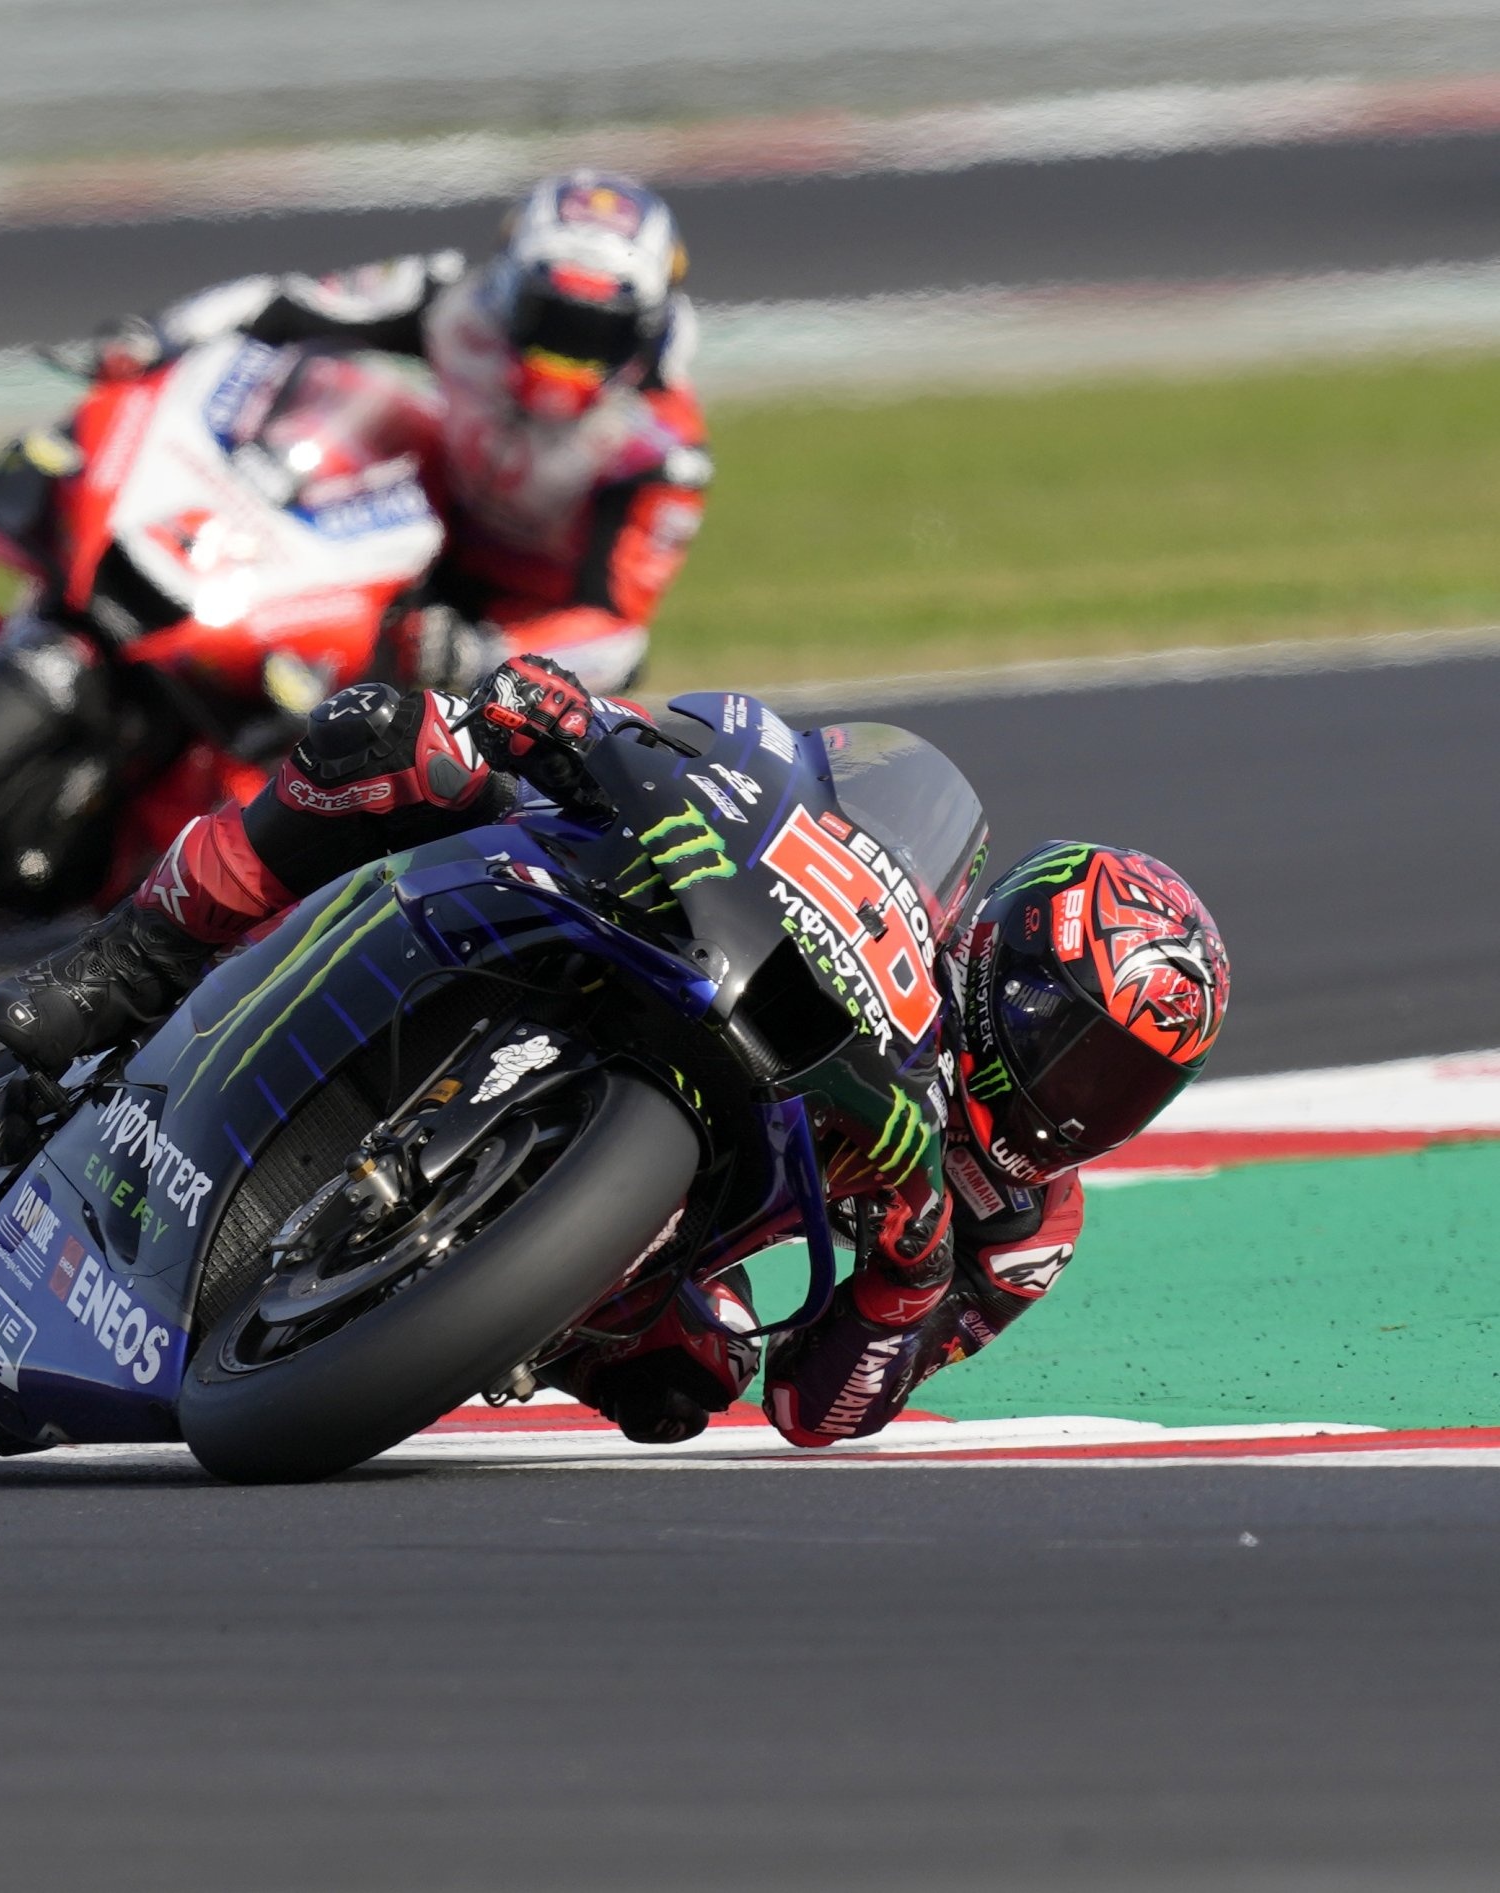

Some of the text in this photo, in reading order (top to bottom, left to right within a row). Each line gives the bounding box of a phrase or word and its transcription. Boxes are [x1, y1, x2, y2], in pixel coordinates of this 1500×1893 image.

[848, 832, 936, 968] ENEOS
[1063, 889, 1085, 951] BS
[769, 880, 893, 1056] MONSTER
[781, 917, 871, 1035] ENERGY
[976, 936, 994, 1053] MONSTER
[11, 1181, 61, 1255] YAMLUBE
[961, 1160, 1000, 1212] YAMAHA
[66, 1255, 169, 1385] ENEOS
[814, 1333, 903, 1435] YAMAHA
